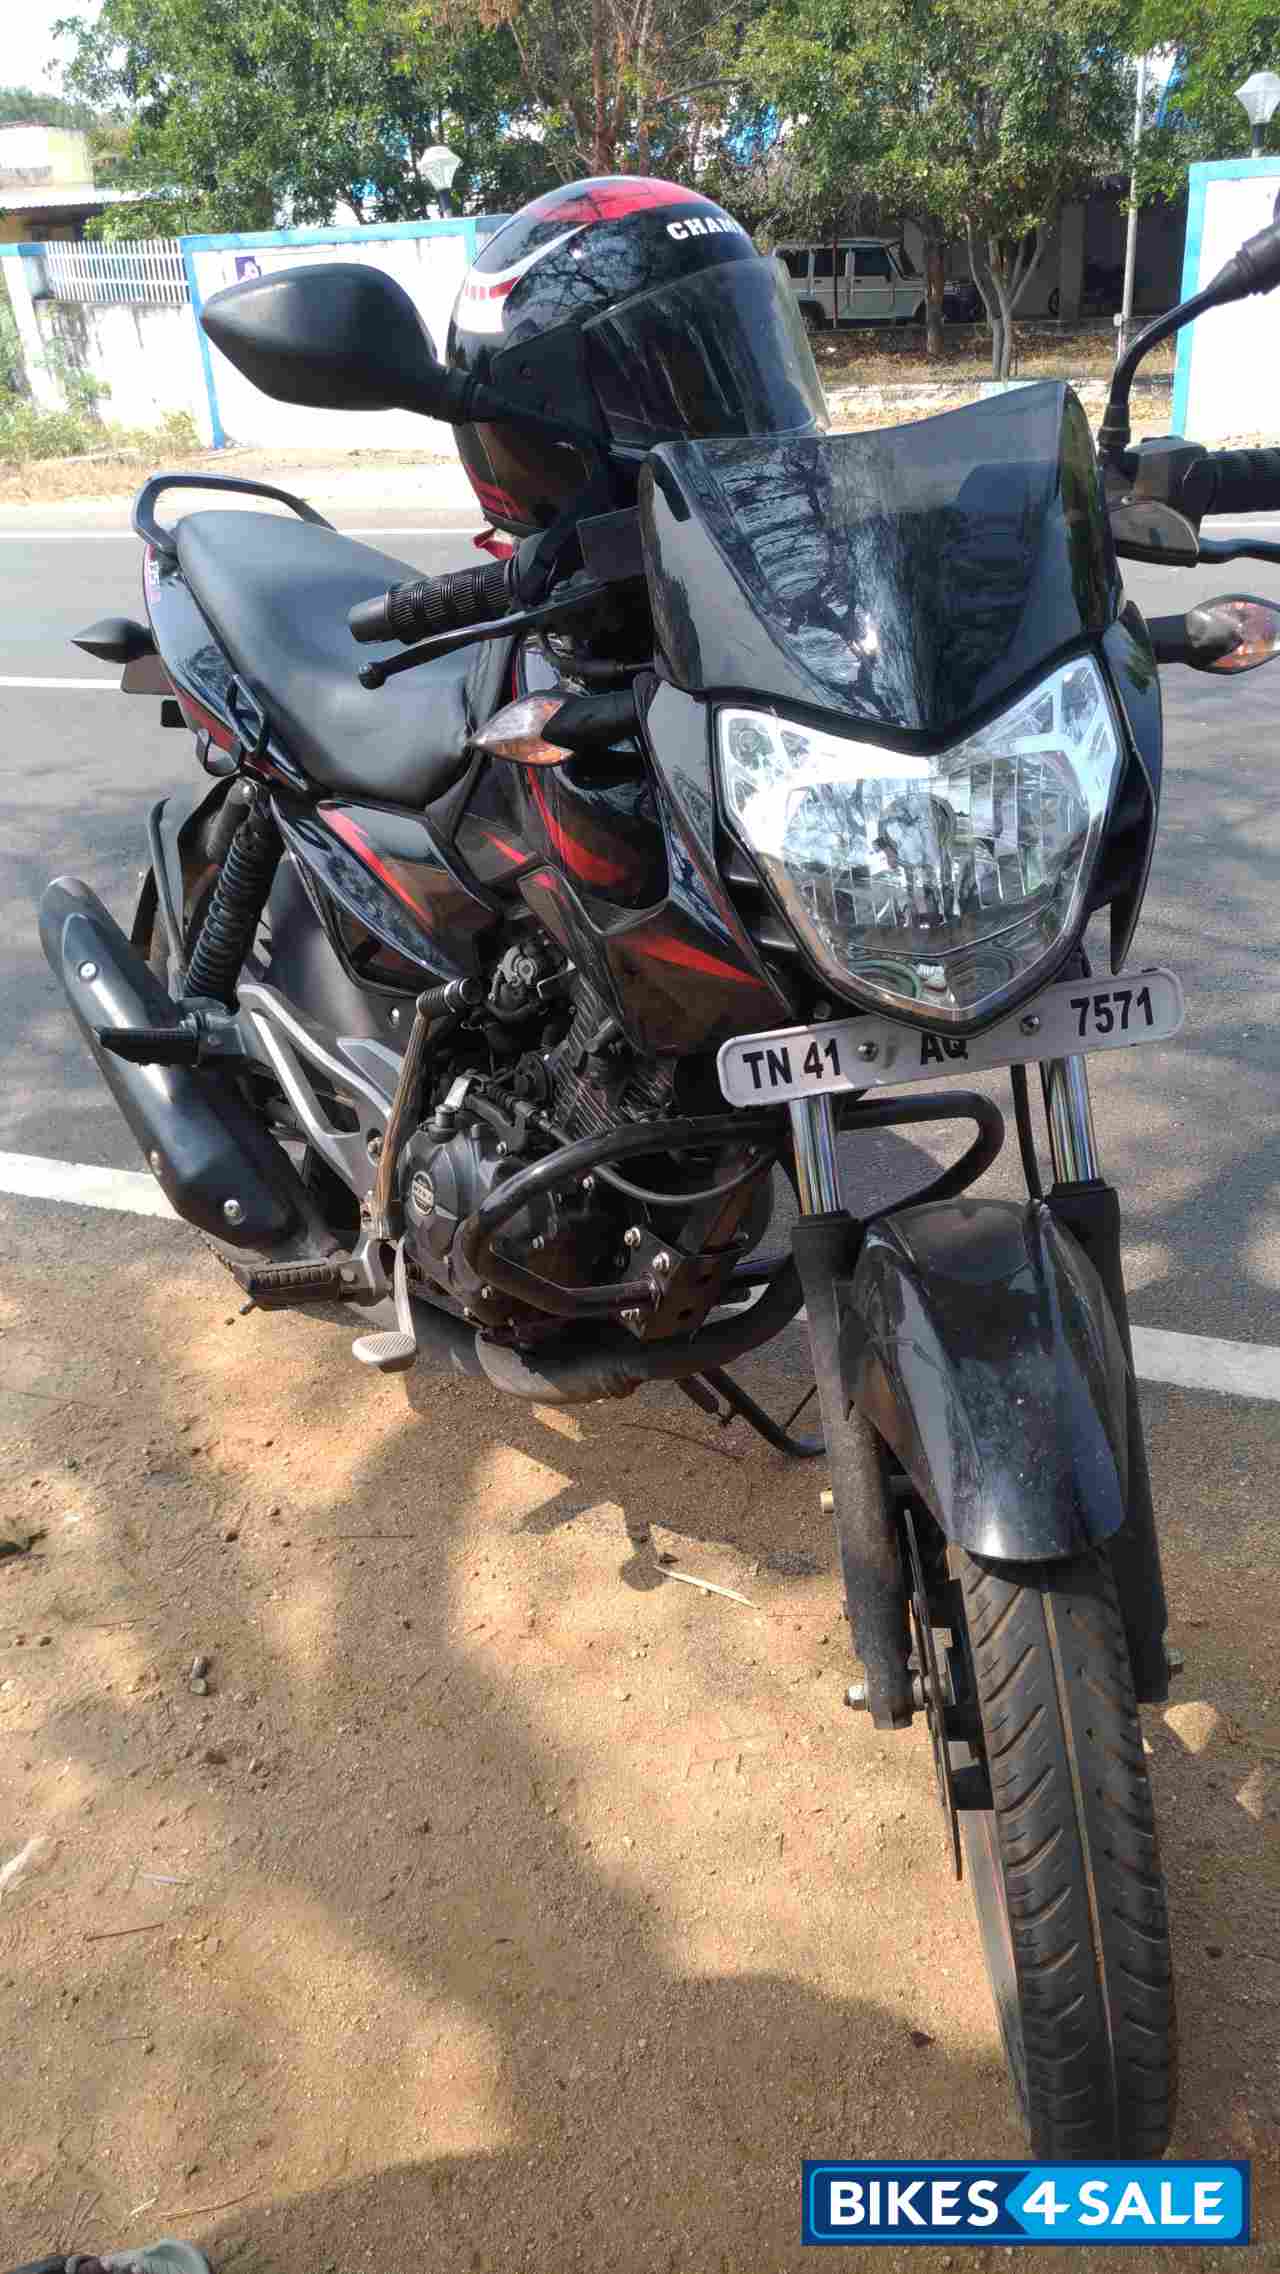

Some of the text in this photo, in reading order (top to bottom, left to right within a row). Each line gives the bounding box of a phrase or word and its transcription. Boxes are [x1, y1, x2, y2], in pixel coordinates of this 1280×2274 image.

[742, 1048, 793, 1089] TN
[803, 1038, 841, 1079] 41
[1070, 986, 1154, 1036] 7571
